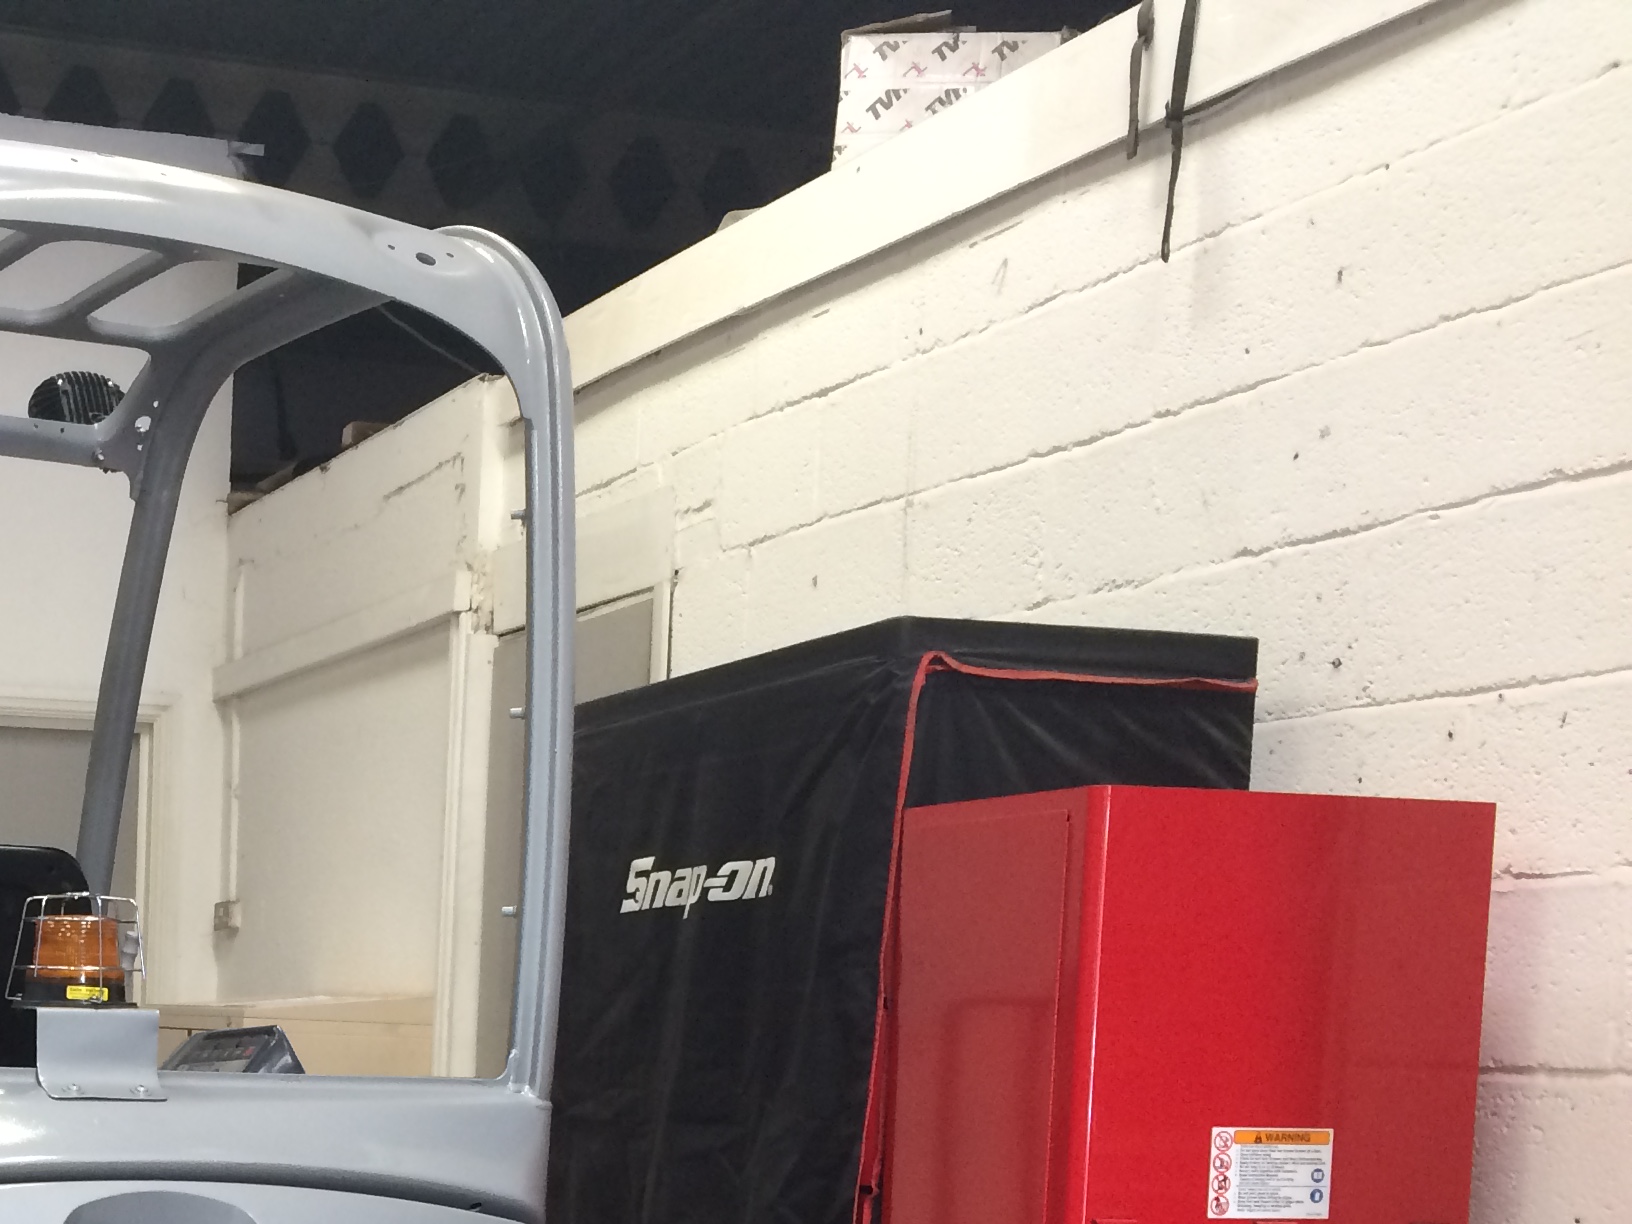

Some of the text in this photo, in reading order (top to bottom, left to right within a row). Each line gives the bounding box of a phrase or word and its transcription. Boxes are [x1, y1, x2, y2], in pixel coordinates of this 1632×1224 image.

[873, 40, 908, 62] TV
[931, 40, 967, 62] TV
[991, 40, 1028, 62] TV
[620, 856, 776, 919] Snap-on
[1265, 1133, 1311, 1143] WARNING
